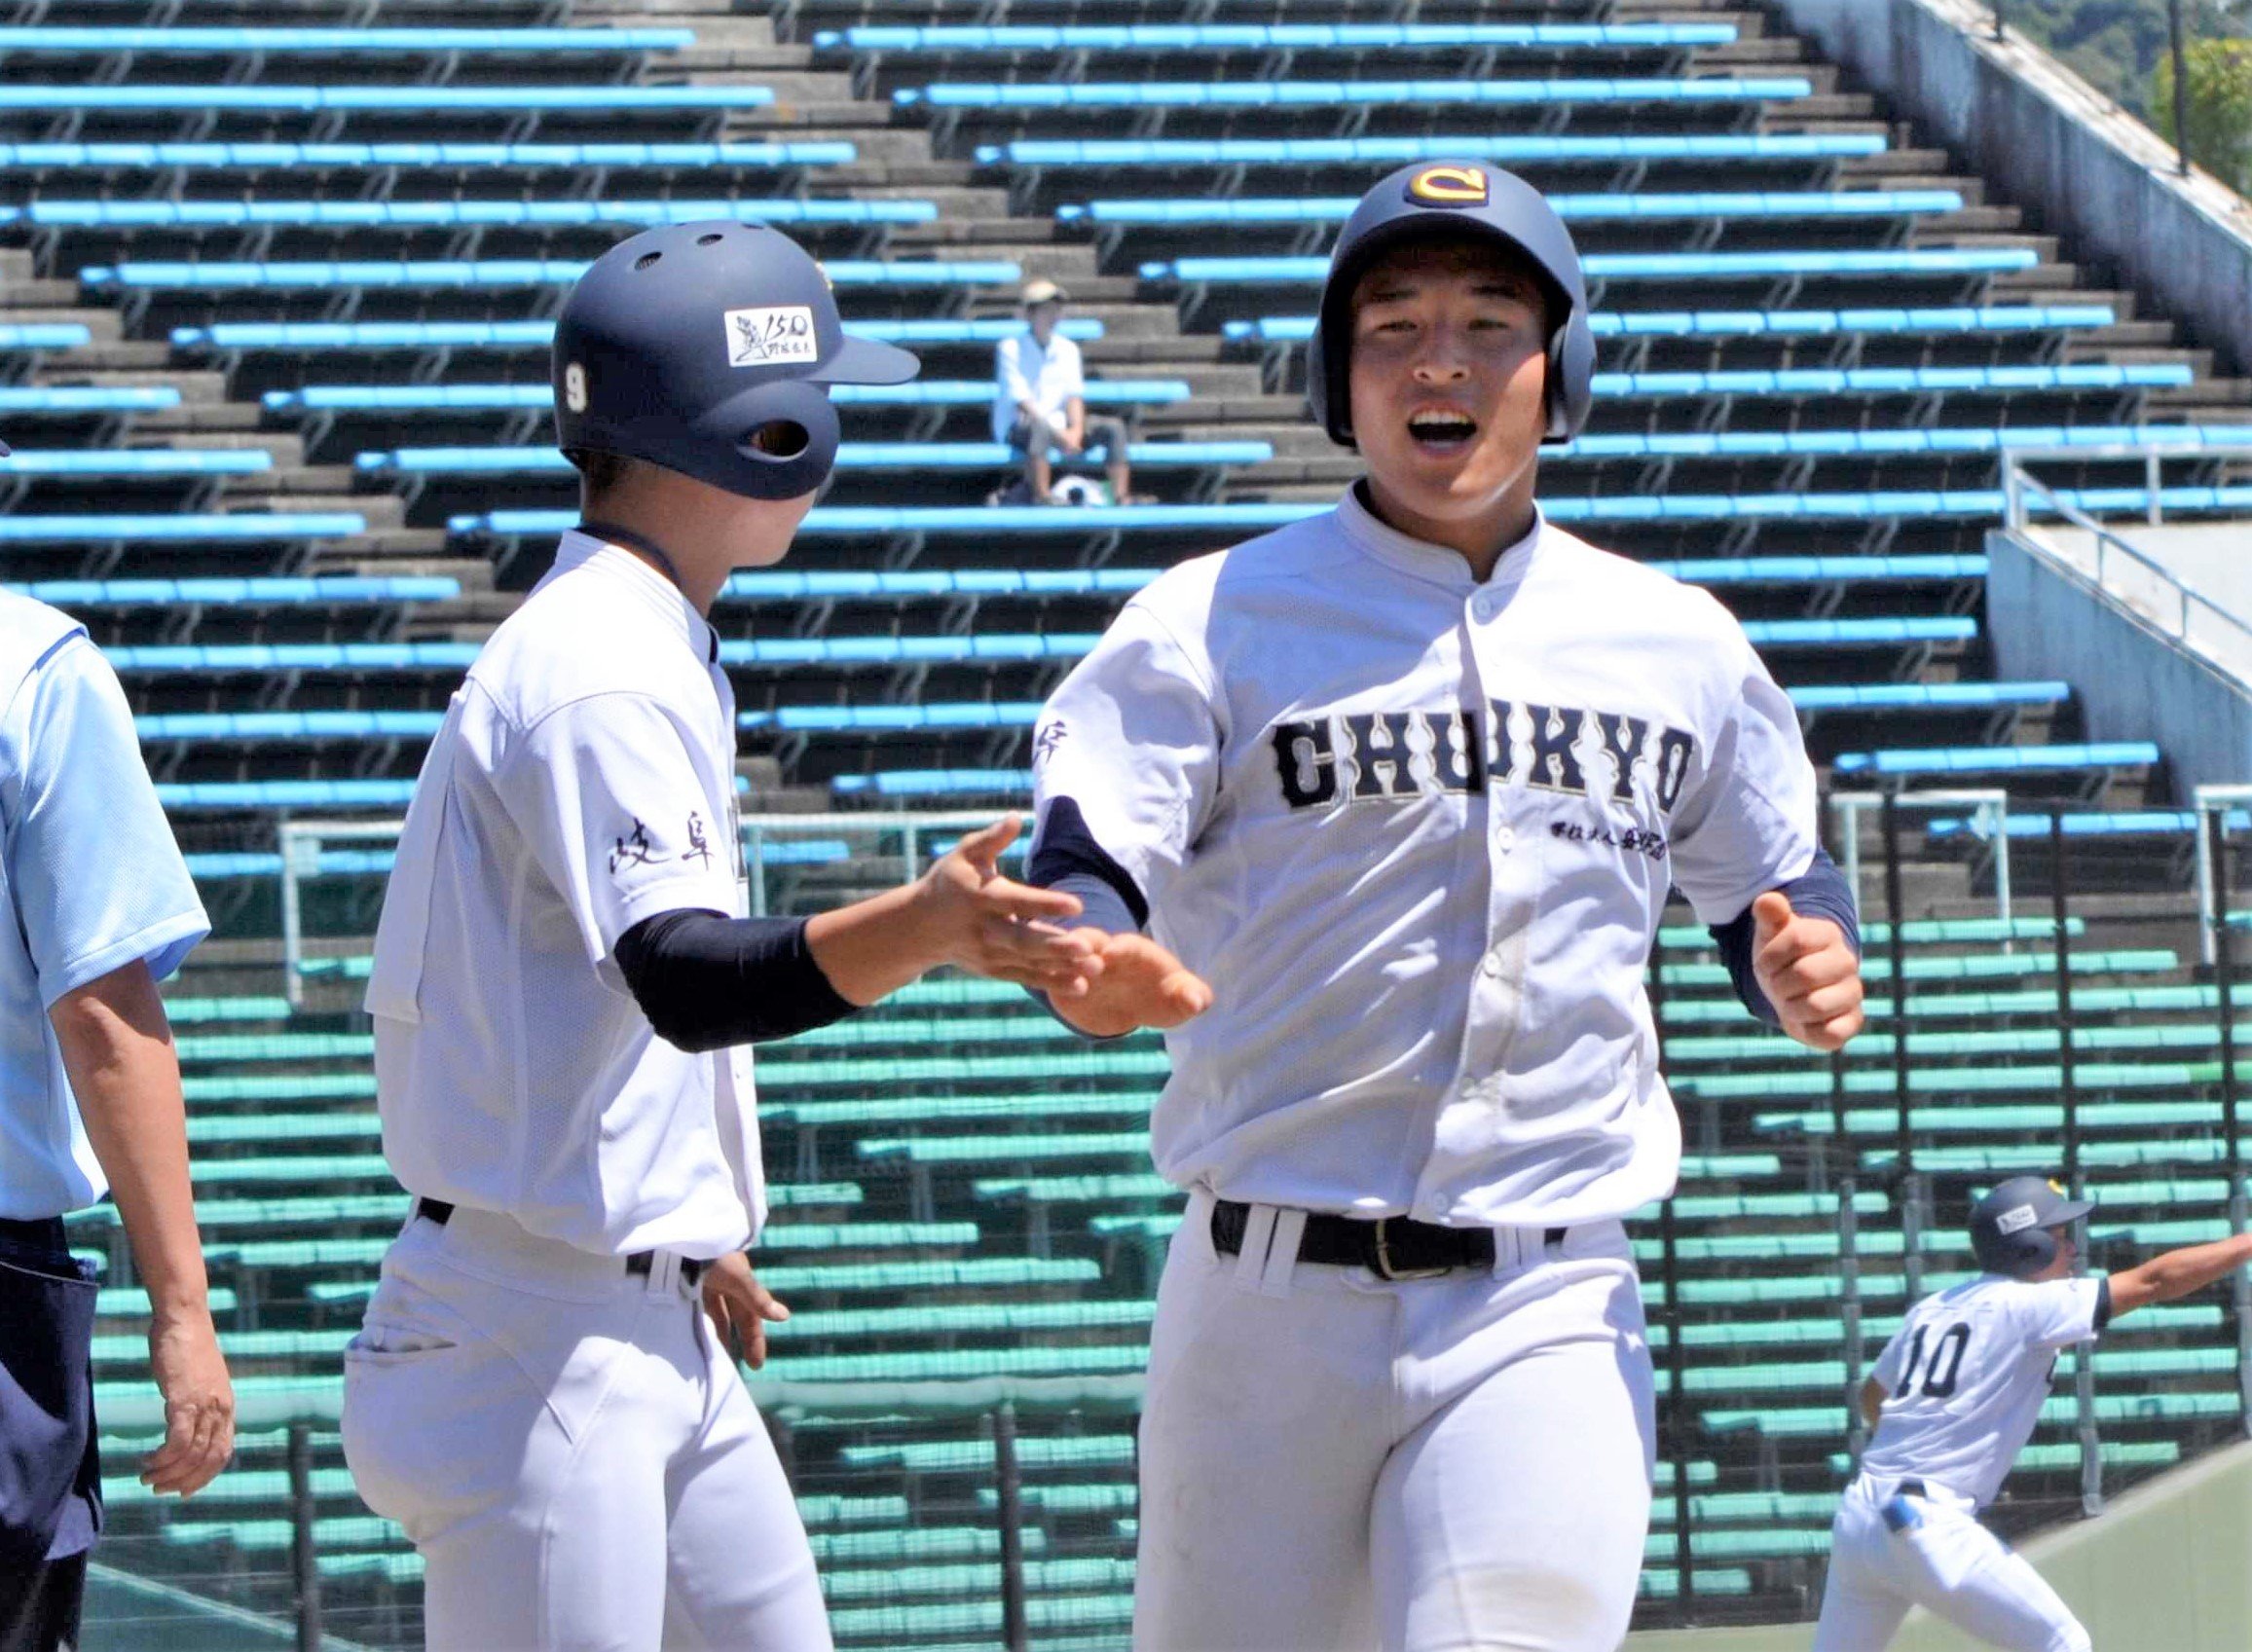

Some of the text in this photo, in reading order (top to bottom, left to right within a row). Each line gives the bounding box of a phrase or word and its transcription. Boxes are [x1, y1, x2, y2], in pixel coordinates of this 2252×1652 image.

[1407, 165, 1489, 204] C
[764, 313, 809, 343] 150
[566, 361, 587, 413] 9
[1273, 698, 1694, 815] CHUKYO
[1896, 1321, 1972, 1399] 10
